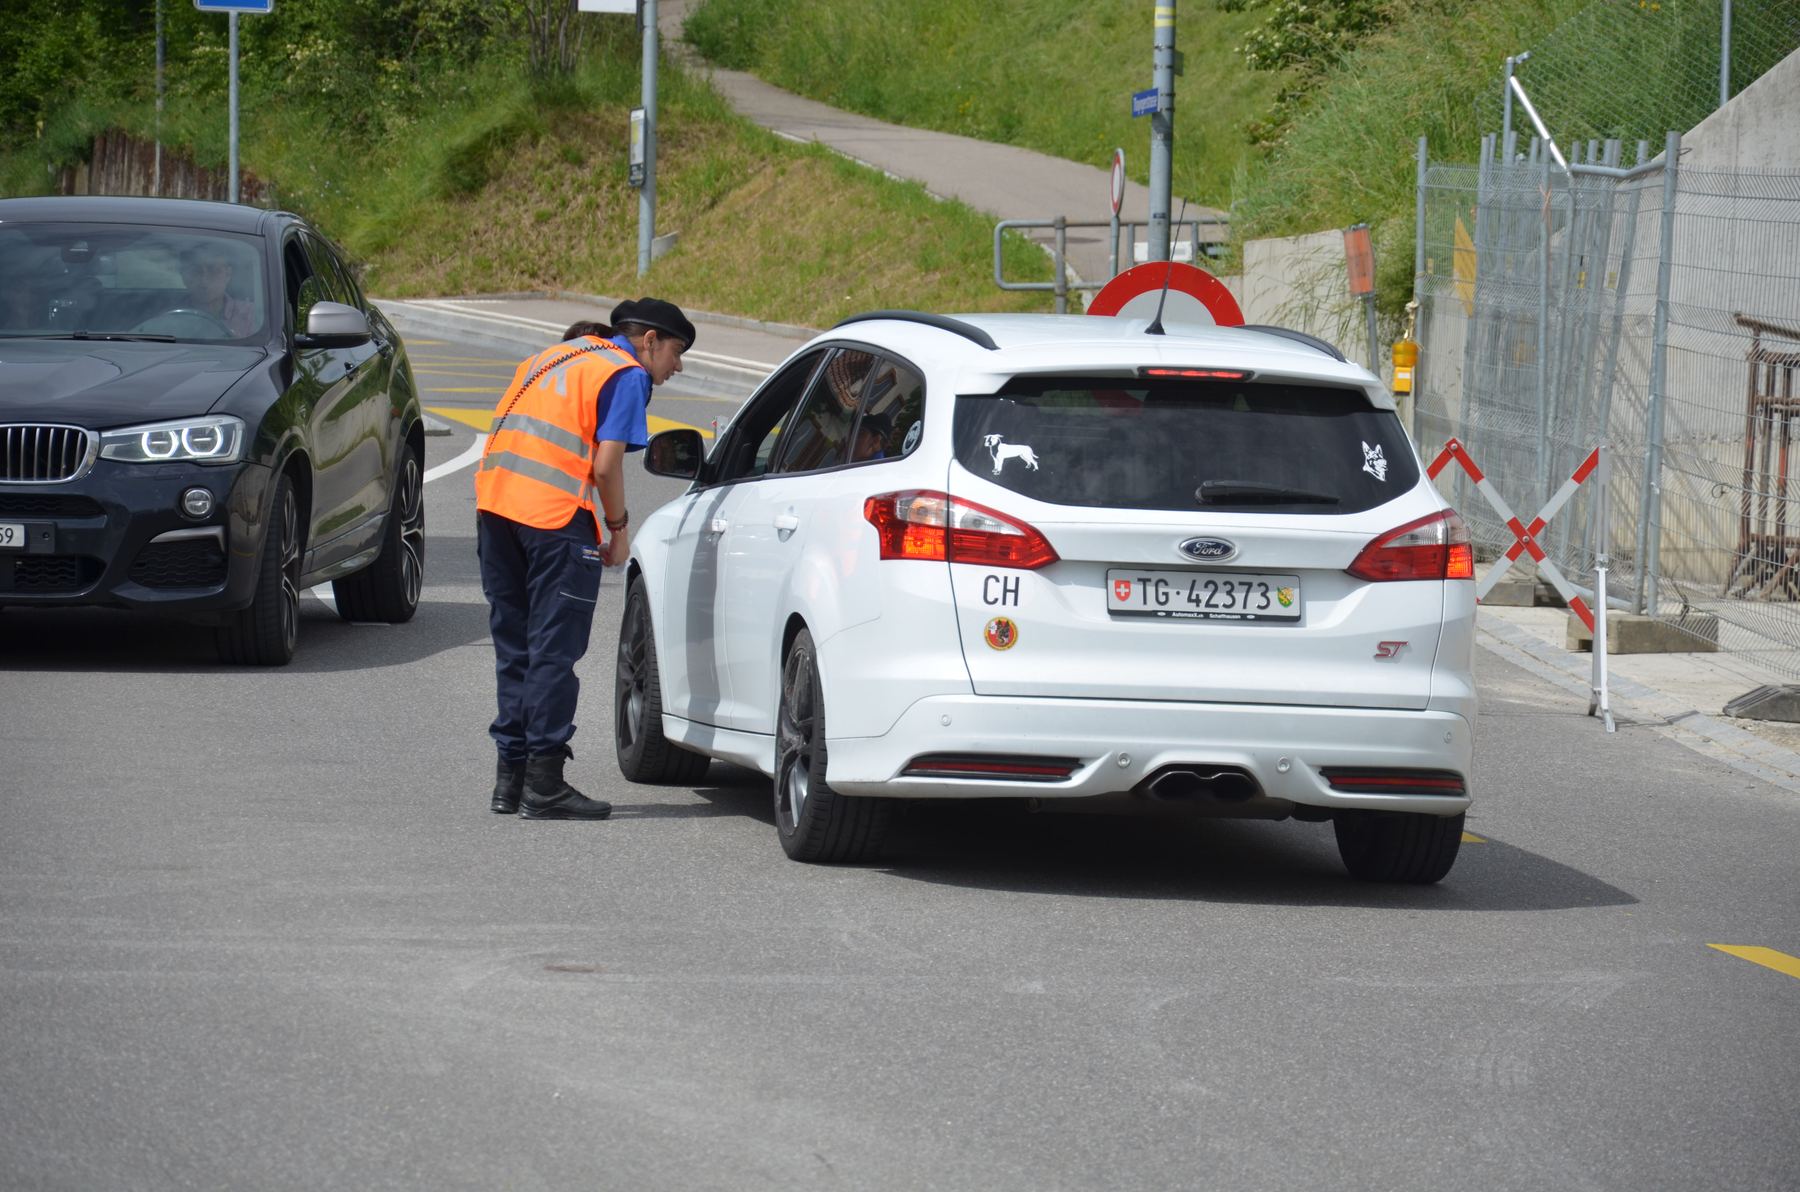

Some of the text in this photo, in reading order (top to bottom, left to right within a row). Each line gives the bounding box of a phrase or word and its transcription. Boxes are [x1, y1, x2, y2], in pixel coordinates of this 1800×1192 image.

[1193, 541, 1224, 555] Ford
[982, 574, 1020, 607] CH
[1375, 641, 1409, 658] ST
